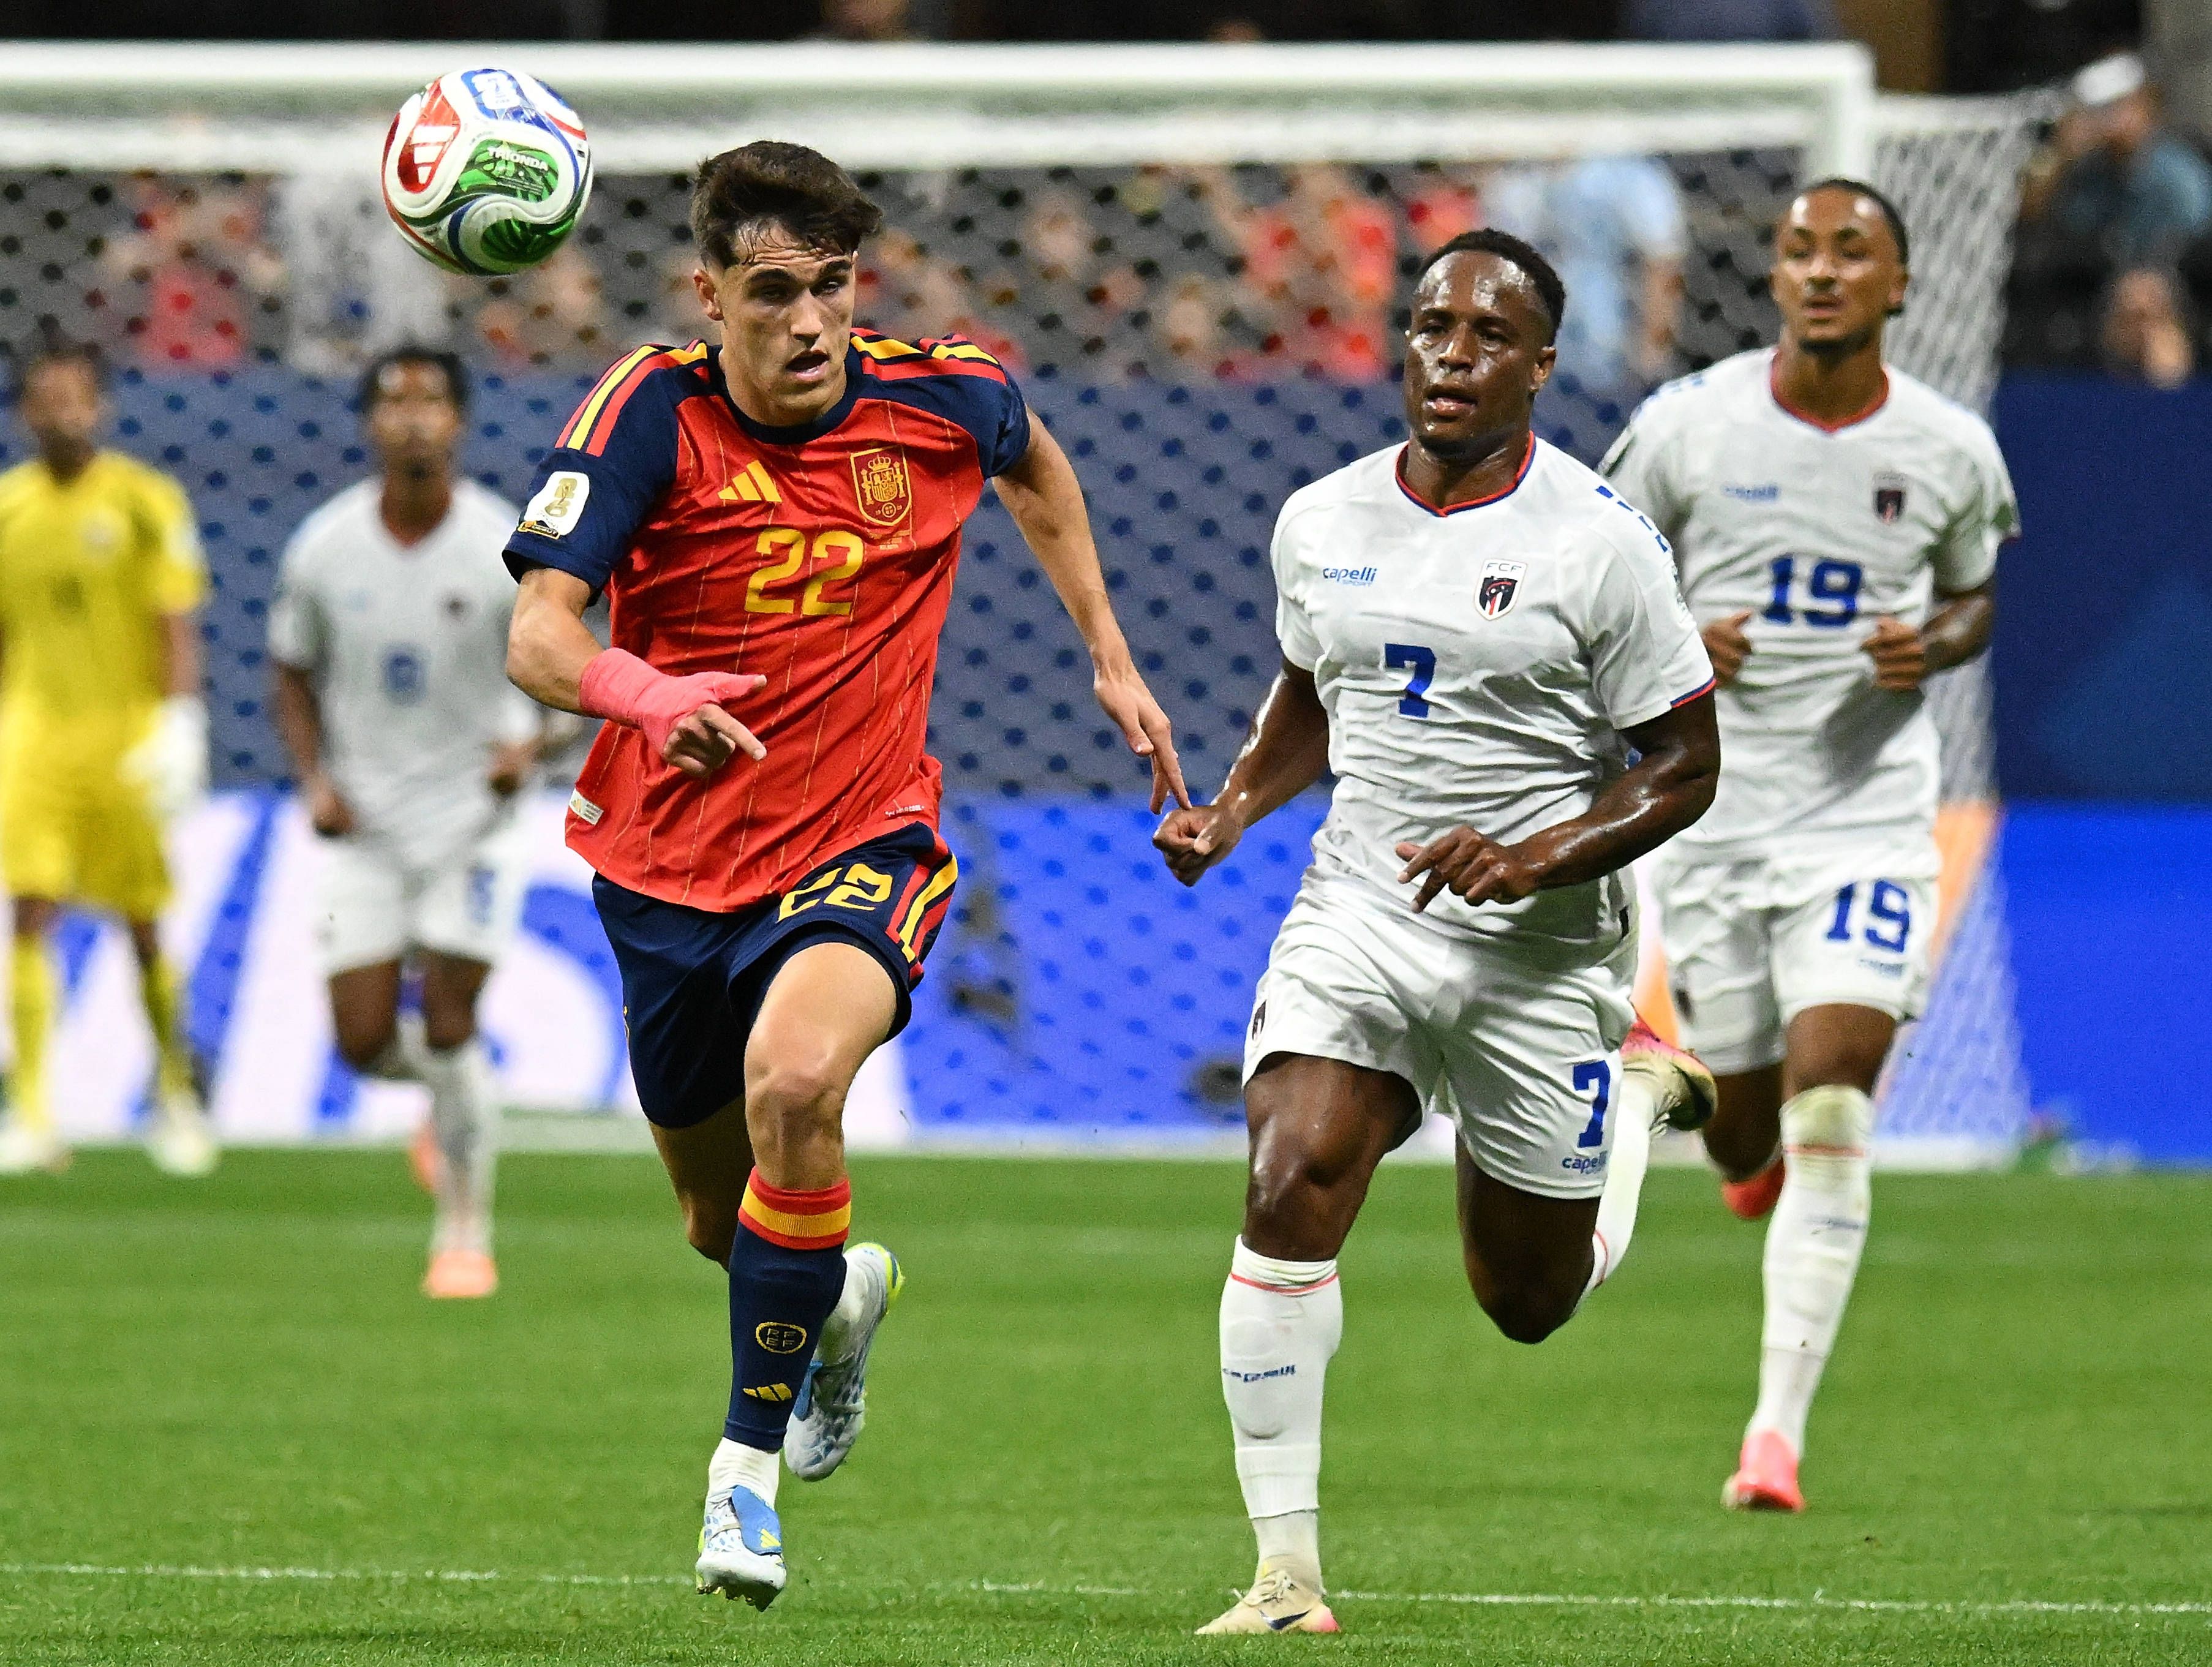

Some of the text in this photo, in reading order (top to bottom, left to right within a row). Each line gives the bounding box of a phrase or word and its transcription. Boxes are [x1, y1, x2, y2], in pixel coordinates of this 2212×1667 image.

[487, 147, 549, 171] TRIONDA
[744, 527, 865, 615] 22
[1323, 566, 1377, 582] capelli
[1486, 562, 1522, 572] FCF
[1764, 554, 1864, 628] 19
[1384, 642, 1437, 718] 7
[776, 864, 893, 923] 22
[1825, 879, 1910, 953] 19
[1573, 1059, 1611, 1148] 7
